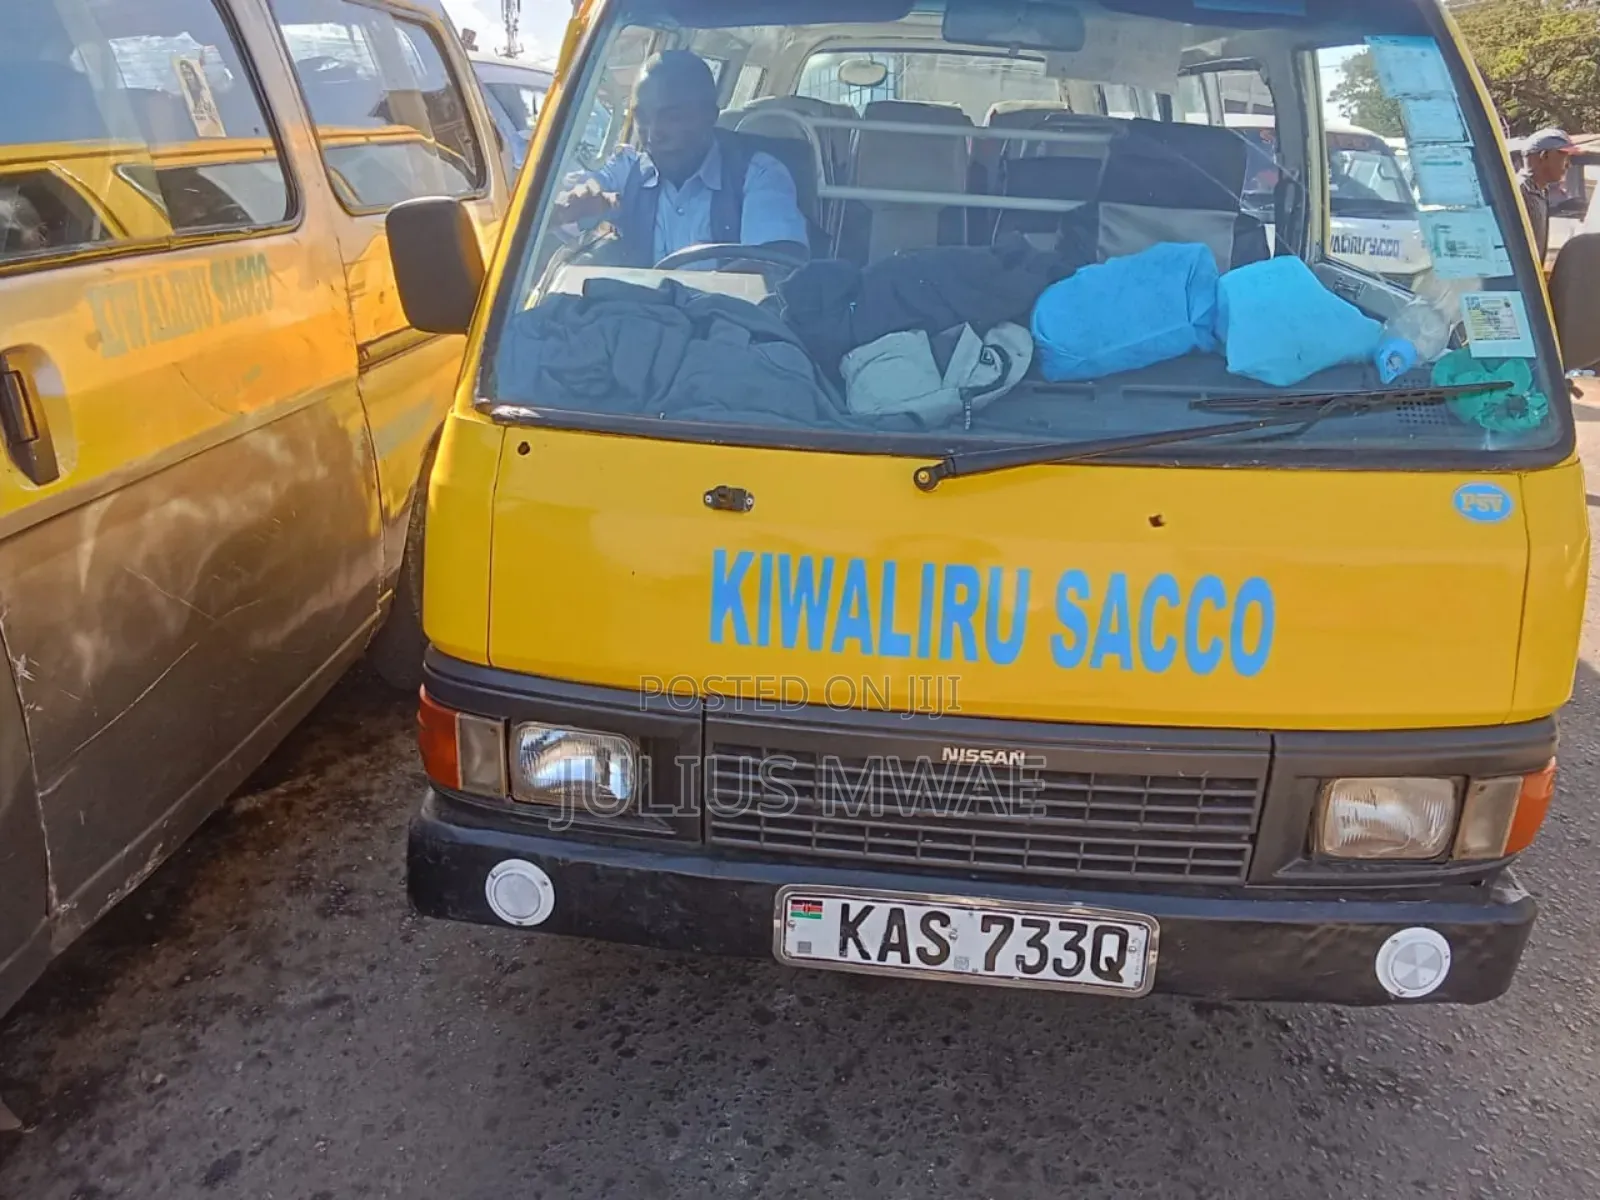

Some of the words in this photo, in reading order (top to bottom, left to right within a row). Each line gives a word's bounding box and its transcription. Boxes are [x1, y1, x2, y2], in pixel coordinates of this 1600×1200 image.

[1460, 493, 1504, 512] PSV
[709, 549, 1031, 665] KIWALIRU
[1050, 569, 1275, 677] SACCO
[942, 747, 1025, 766] NISSAN
[838, 902, 951, 963] KAS
[980, 914, 1128, 983] 733Q
